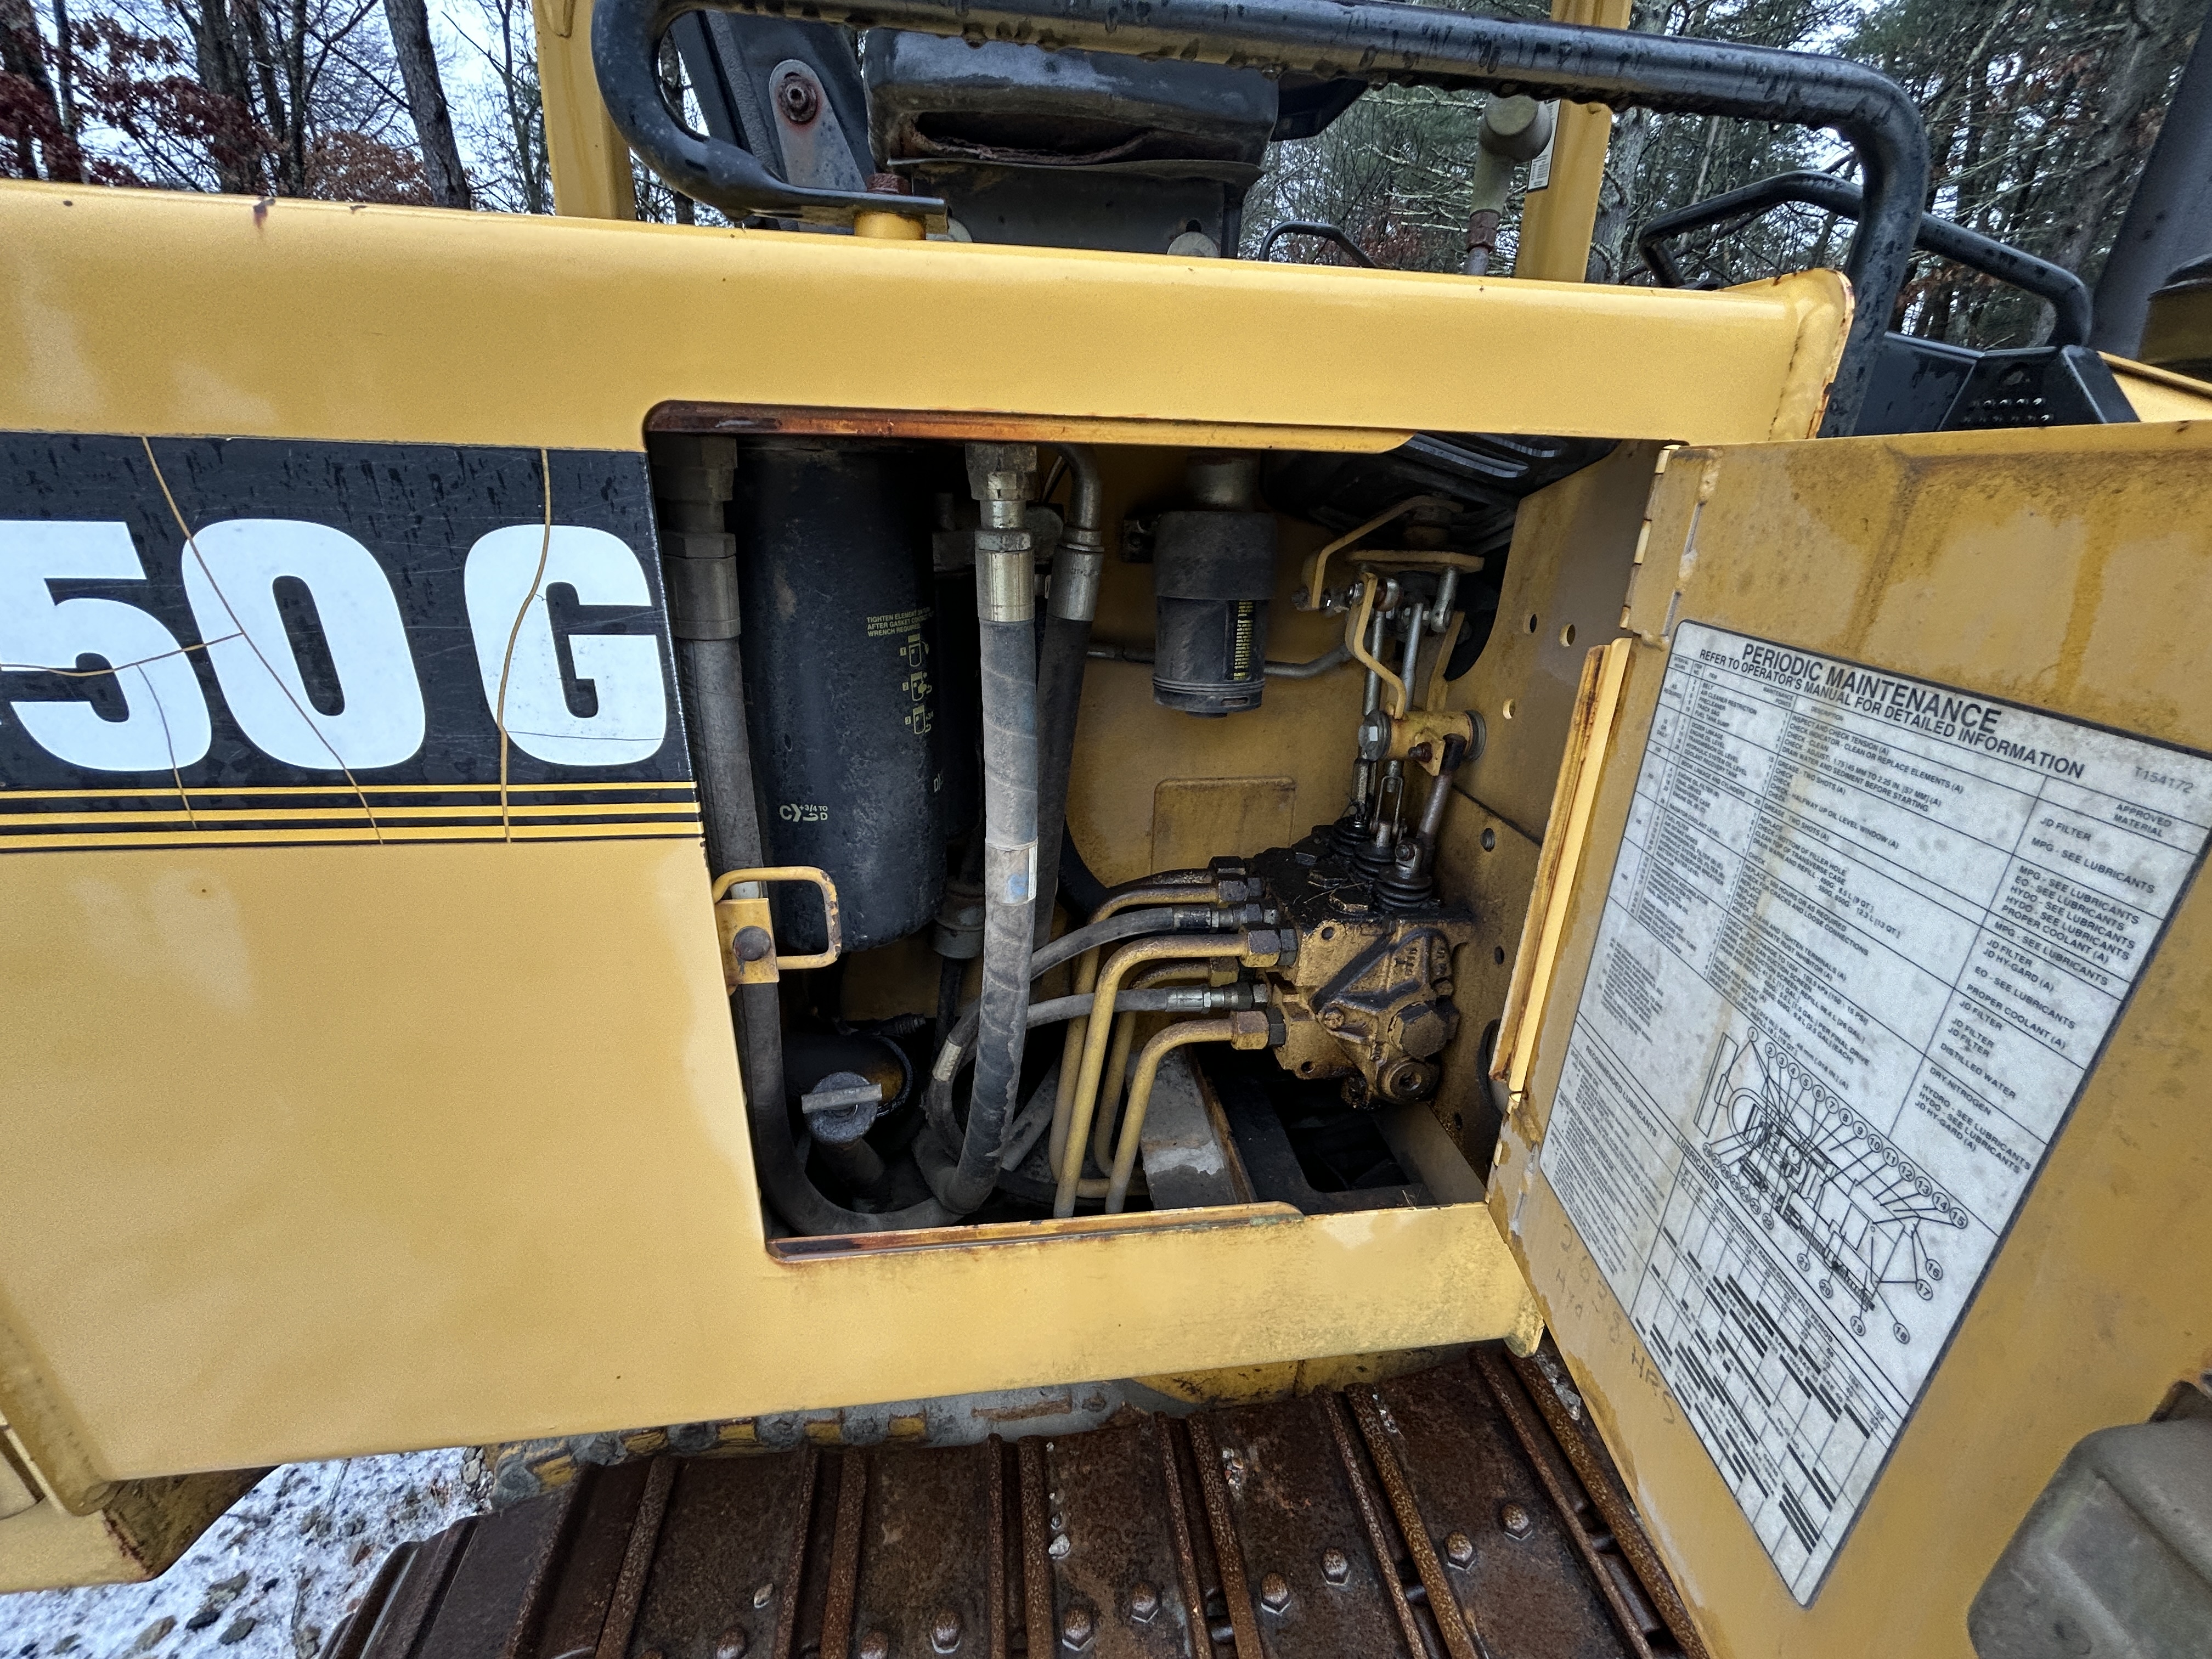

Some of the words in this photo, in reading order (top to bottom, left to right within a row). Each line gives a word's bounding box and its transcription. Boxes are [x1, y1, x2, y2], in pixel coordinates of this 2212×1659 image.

[867, 614, 894, 623] TIGHTEN
[867, 622, 888, 630] AFTER
[889, 618, 911, 627] GASKET
[867, 628, 895, 637] WRENCH
[464, 524, 667, 766] G
[1741, 642, 1824, 682] PERIODIC
[1825, 665, 2002, 735] MAINTENANCE
[1699, 648, 1727, 666] REFER
[1726, 657, 1741, 670] TO
[1740, 661, 1803, 690] OPERATOR'S
[1803, 681, 1853, 706] MANUAL
[1854, 696, 1883, 715] FOR
[1883, 704, 1957, 738] DETAILED
[1957, 727, 2086, 779] INFORMATION
[1791, 715, 1815, 728] INSPECT
[1814, 723, 1829, 733] AND
[1827, 727, 1850, 741] CHECK
[1850, 736, 1879, 752] TENSION
[1877, 746, 1890, 757] (A)
[1810, 706, 1844, 721] DESCRIPTION
[1786, 730, 1805, 743] CHECK
[1808, 739, 1829, 752] CLEAN
[1767, 789, 1786, 803] CHECK
[1772, 775, 1791, 788] CHECK
[1774, 767, 1793, 780] CHECK
[2131, 766, 2196, 794] T154172
[820, 812, 828, 820] D
[2039, 816, 2055, 828] JD
[2054, 821, 2093, 842] FILTER
[2112, 814, 2165, 837] MATERIAL
[2115, 803, 2174, 828] APPROVED
[2030, 837, 2055, 853] MPG
[2059, 849, 2083, 865] SEE
[2082, 858, 2157, 895] LUBRICANTS
[2009, 885, 2040, 904] HYDO
[2044, 901, 2066, 917] SEE
[2065, 911, 2137, 950] LUBRICANTS
[2013, 874, 2030, 888] EO
[2034, 884, 2057, 900] SEE
[2056, 894, 2126, 932] LUBRICANTS
[2018, 865, 2042, 881] MPG
[2047, 878, 2069, 894] SEE
[2068, 888, 2141, 925] LUBRICANTS
[2000, 904, 2042, 930] PROPER
[2041, 924, 2093, 955] COOLANT
[2091, 950, 2111, 965] (A)
[2005, 894, 2035, 914] HYDO
[2039, 911, 2062, 928] SEE
[2059, 921, 2131, 961] LUBRICANTS
[1982, 947, 1996, 960] JD
[1995, 954, 2040, 984] HY-GARD
[2038, 978, 2056, 994] (A)
[1986, 938, 2000, 950] JD
[1999, 945, 2034, 968] FILTER
[1993, 921, 2017, 938] MPG
[2021, 935, 2042, 951] SEE
[2041, 945, 2110, 987] LUBRICANTS
[1959, 999, 1973, 1012] JD
[1971, 1006, 2004, 1031] FILTER
[1966, 983, 2004, 1011] PROPER
[2002, 1006, 2051, 1040] COOLANT
[2049, 1035, 2067, 1051] (A)
[1973, 965, 1989, 979] EO
[1993, 977, 2013, 993] SEE
[2011, 988, 2076, 1030] LUBRICANTS
[1947, 1025, 1961, 1039] JD
[1958, 1032, 1991, 1059] FILTER
[1951, 1016, 1965, 1030] JD
[1962, 1023, 1995, 1049] FILTER
[1585, 1044, 1623, 1094] RECOMMENDED
[1622, 1090, 1657, 1138] LUBRICANTS
[1929, 1066, 1949, 1085] DRY
[1945, 1079, 1992, 1116] NITROGEN
[1939, 1042, 1984, 1077] DISTILLED
[1982, 1072, 2017, 1101] WATER
[1915, 1098, 1927, 1112] JD
[1926, 1107, 1964, 1141] HY-GARD
[1962, 1137, 1978, 1153] (A)
[1918, 1091, 1942, 1113] HYDO
[1946, 1113, 1964, 1131] SEE
[1963, 1126, 2022, 1175] LUBRICANTS
[1921, 1082, 1951, 1109] HYDRO
[1955, 1108, 1974, 1126] SEE
[1973, 1122, 2032, 1171] LUBRICANTS
[1675, 1134, 1720, 1192] LUBRICANTS
